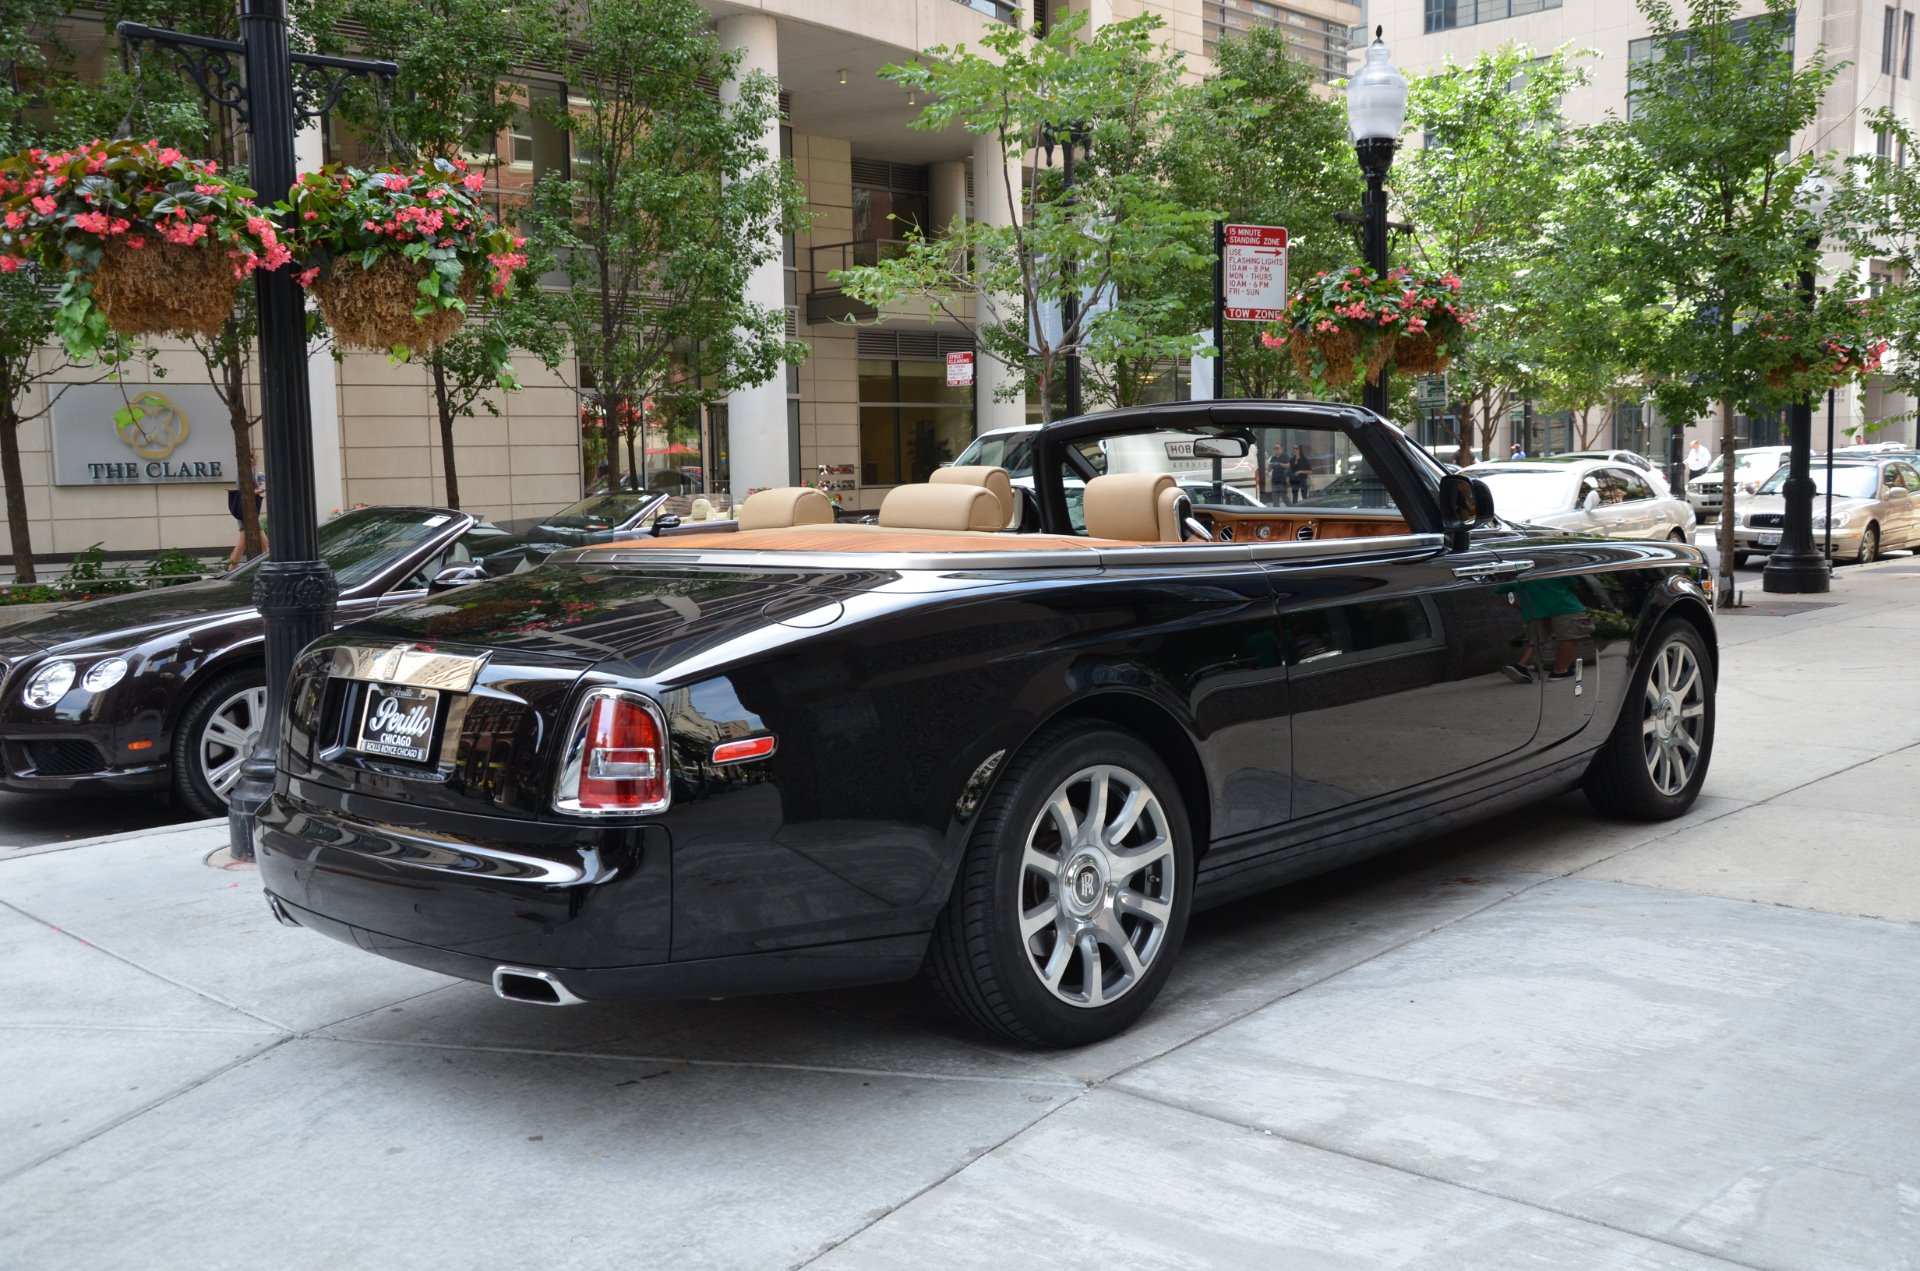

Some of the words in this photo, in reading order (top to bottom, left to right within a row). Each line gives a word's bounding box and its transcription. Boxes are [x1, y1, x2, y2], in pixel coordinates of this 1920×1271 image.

[1238, 229, 1262, 237] MINUTE
[1229, 236, 1261, 245] STANDING
[1264, 238, 1280, 246] ZONE
[1229, 248, 1242, 256] USE
[1262, 258, 1283, 266] LIGHTS
[1251, 273, 1273, 281] THURS
[1229, 309, 1250, 318] TOW
[1255, 310, 1281, 319] ZONE
[1170, 445, 1191, 453] HOB
[88, 462, 139, 479] THE
[146, 462, 223, 478] CLARE
[391, 687, 413, 696] Perillo
[369, 697, 430, 737] Perillo
[380, 733, 412, 746] CHICAGO
[366, 743, 381, 752] ROLLS
[381, 745, 397, 755] ROYCE
[397, 748, 418, 758] CHICAGO
